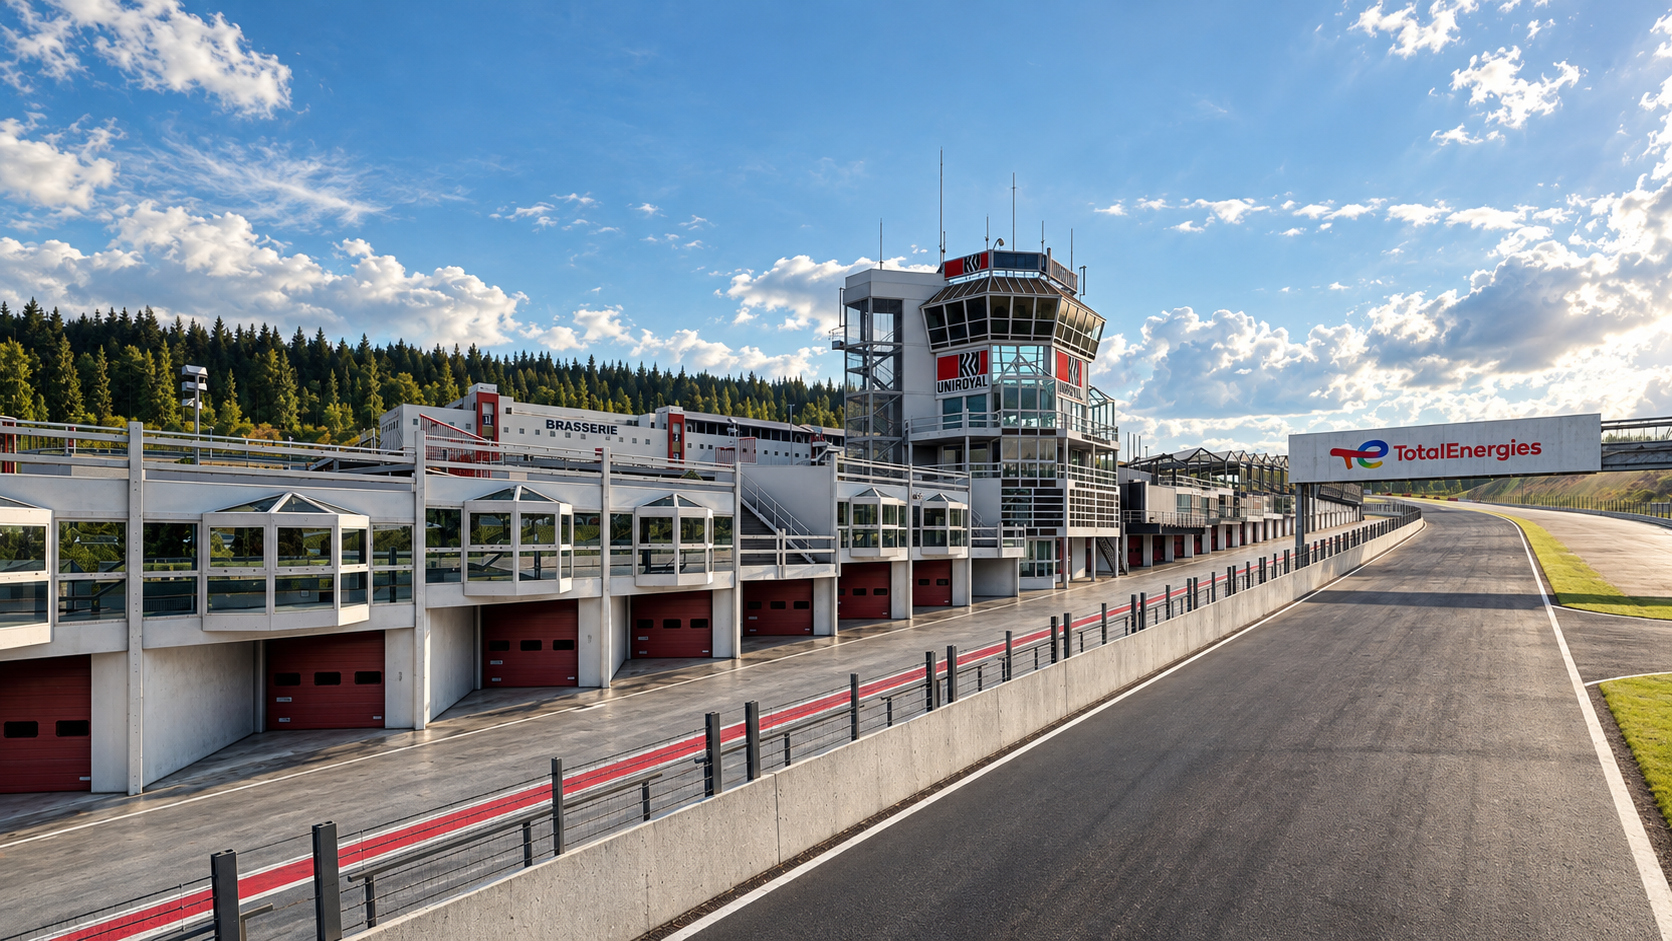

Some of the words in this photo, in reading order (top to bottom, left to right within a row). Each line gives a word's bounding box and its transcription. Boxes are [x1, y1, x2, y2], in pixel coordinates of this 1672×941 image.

[937, 375, 988, 393] UNIROYAL
[546, 419, 618, 435] BRASSERIE
[1394, 439, 1542, 461] TotalEnergies
